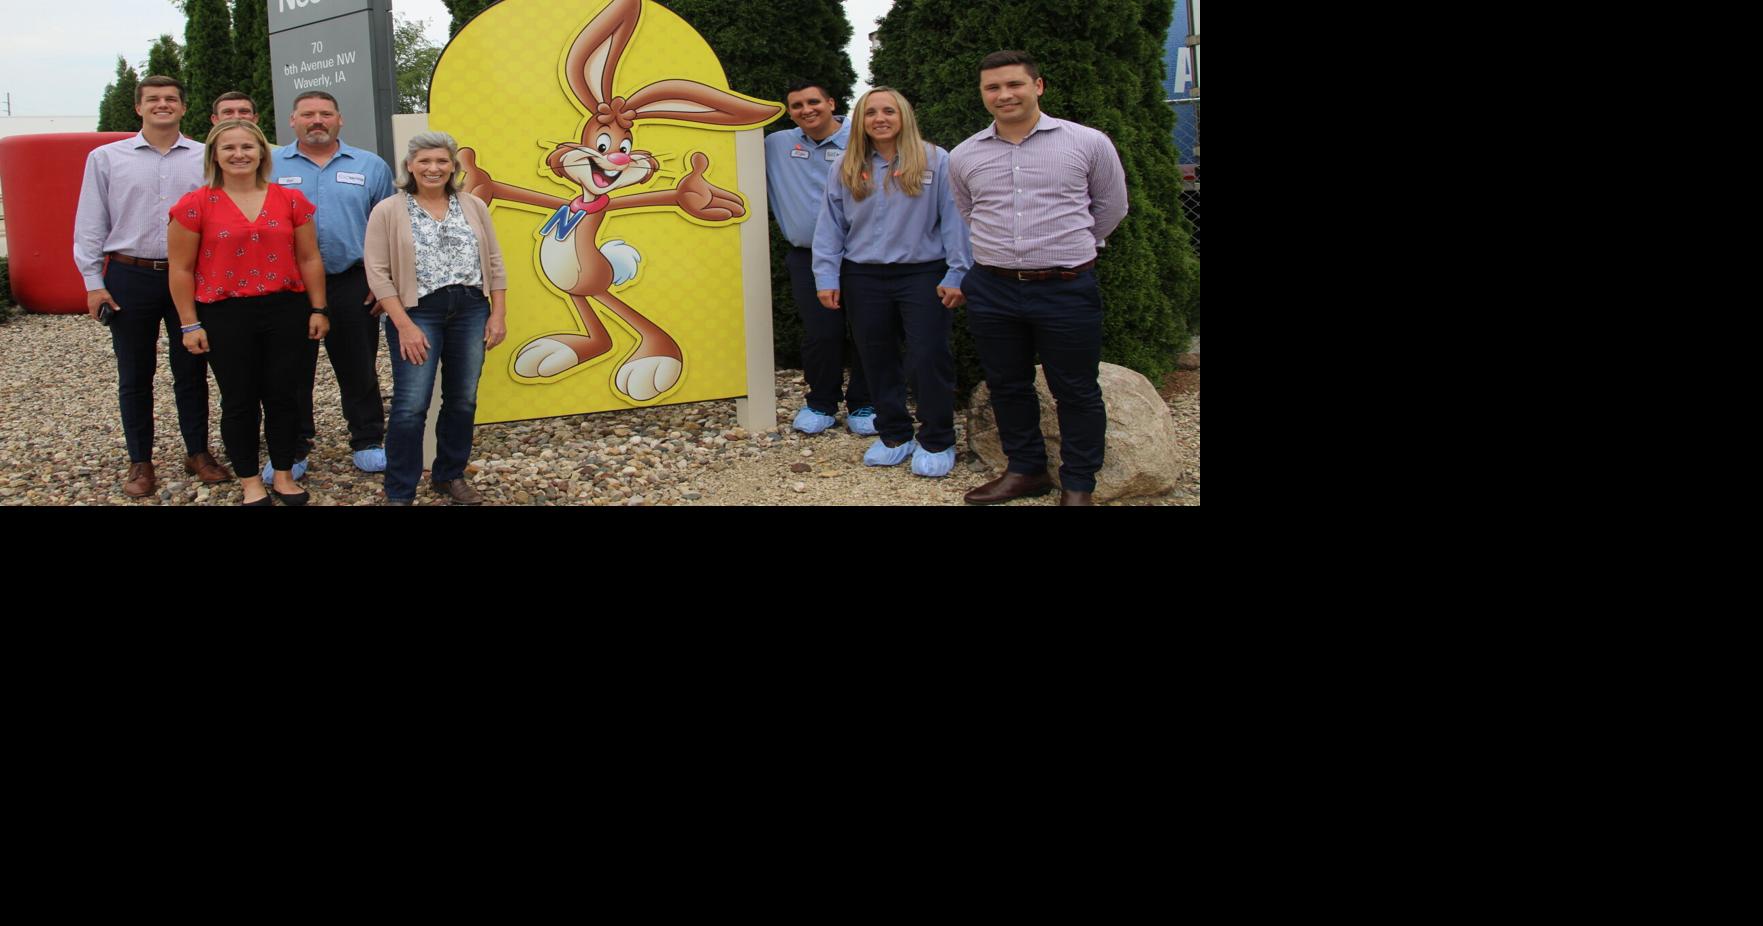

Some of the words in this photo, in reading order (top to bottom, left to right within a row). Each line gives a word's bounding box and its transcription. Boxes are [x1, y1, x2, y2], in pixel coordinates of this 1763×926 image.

[311, 41, 323, 54] 70
[284, 63, 298, 76] 6th
[300, 58, 334, 73] Avenue
[336, 50, 356, 66] NW
[293, 73, 332, 90] Waverly,
[335, 70, 347, 84] IA
[540, 205, 587, 241] N
